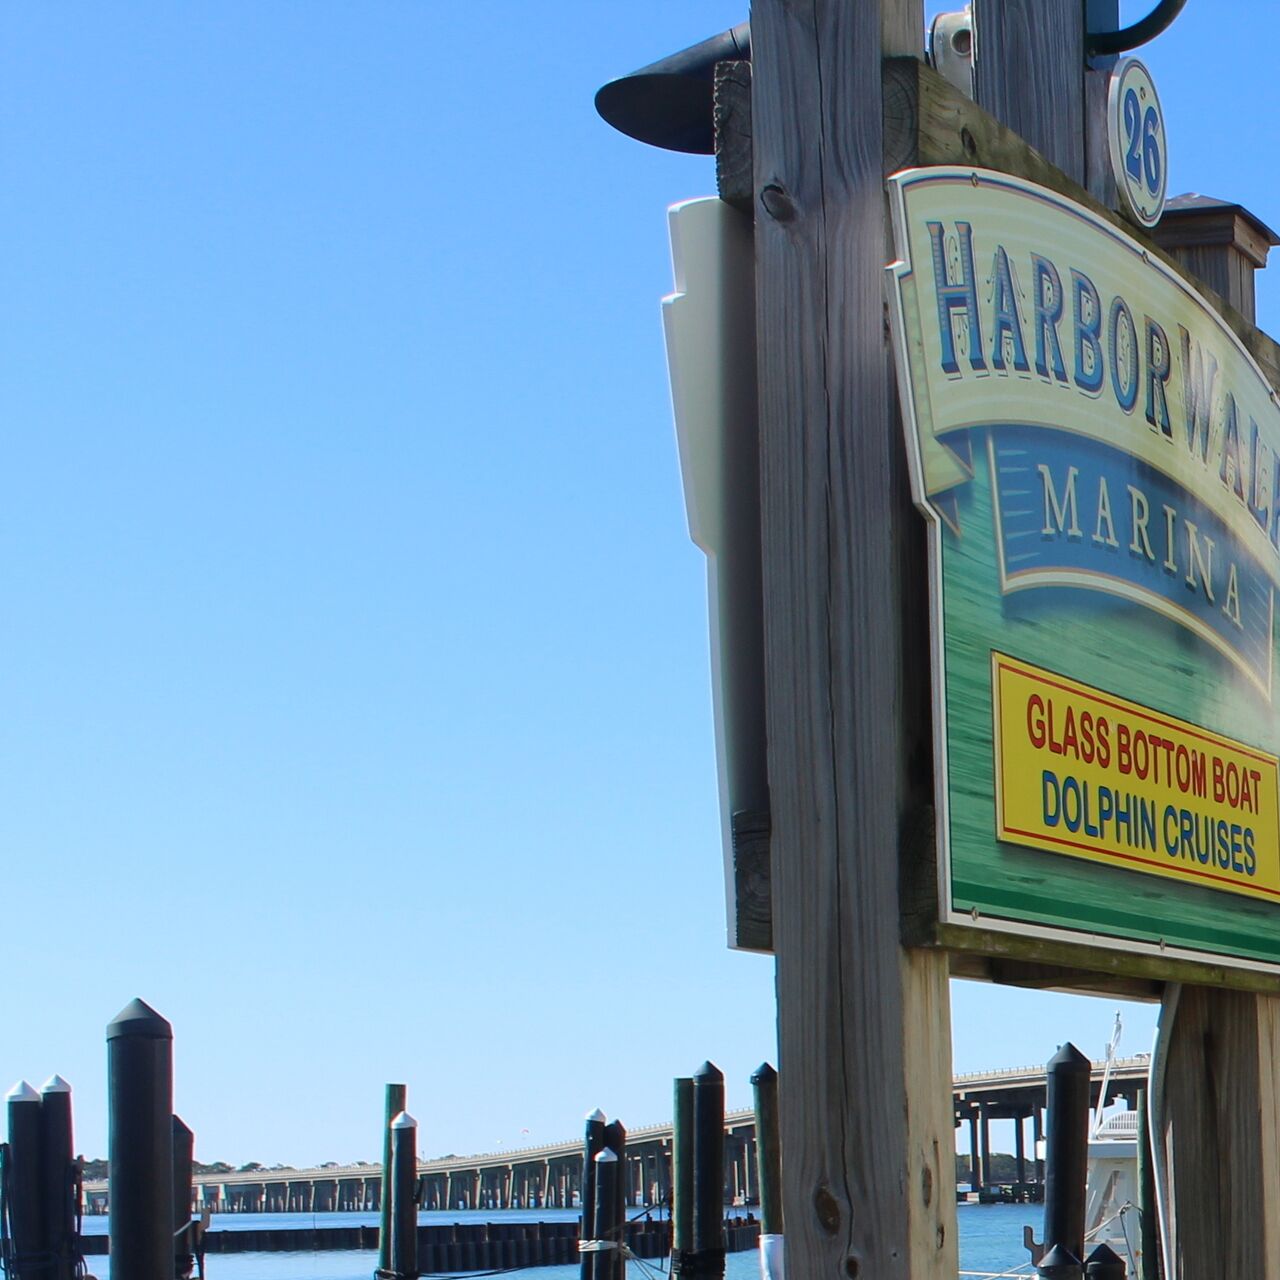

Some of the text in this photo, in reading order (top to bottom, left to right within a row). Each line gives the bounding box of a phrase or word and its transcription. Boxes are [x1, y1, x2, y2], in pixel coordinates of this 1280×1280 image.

[1123, 87, 1159, 196] 26
[1037, 463, 1245, 632] MARINA
[1027, 693, 1262, 815] GLASS BOTTOM BOAT
[1042, 769, 1256, 877] DOLPHIN CRUISES
